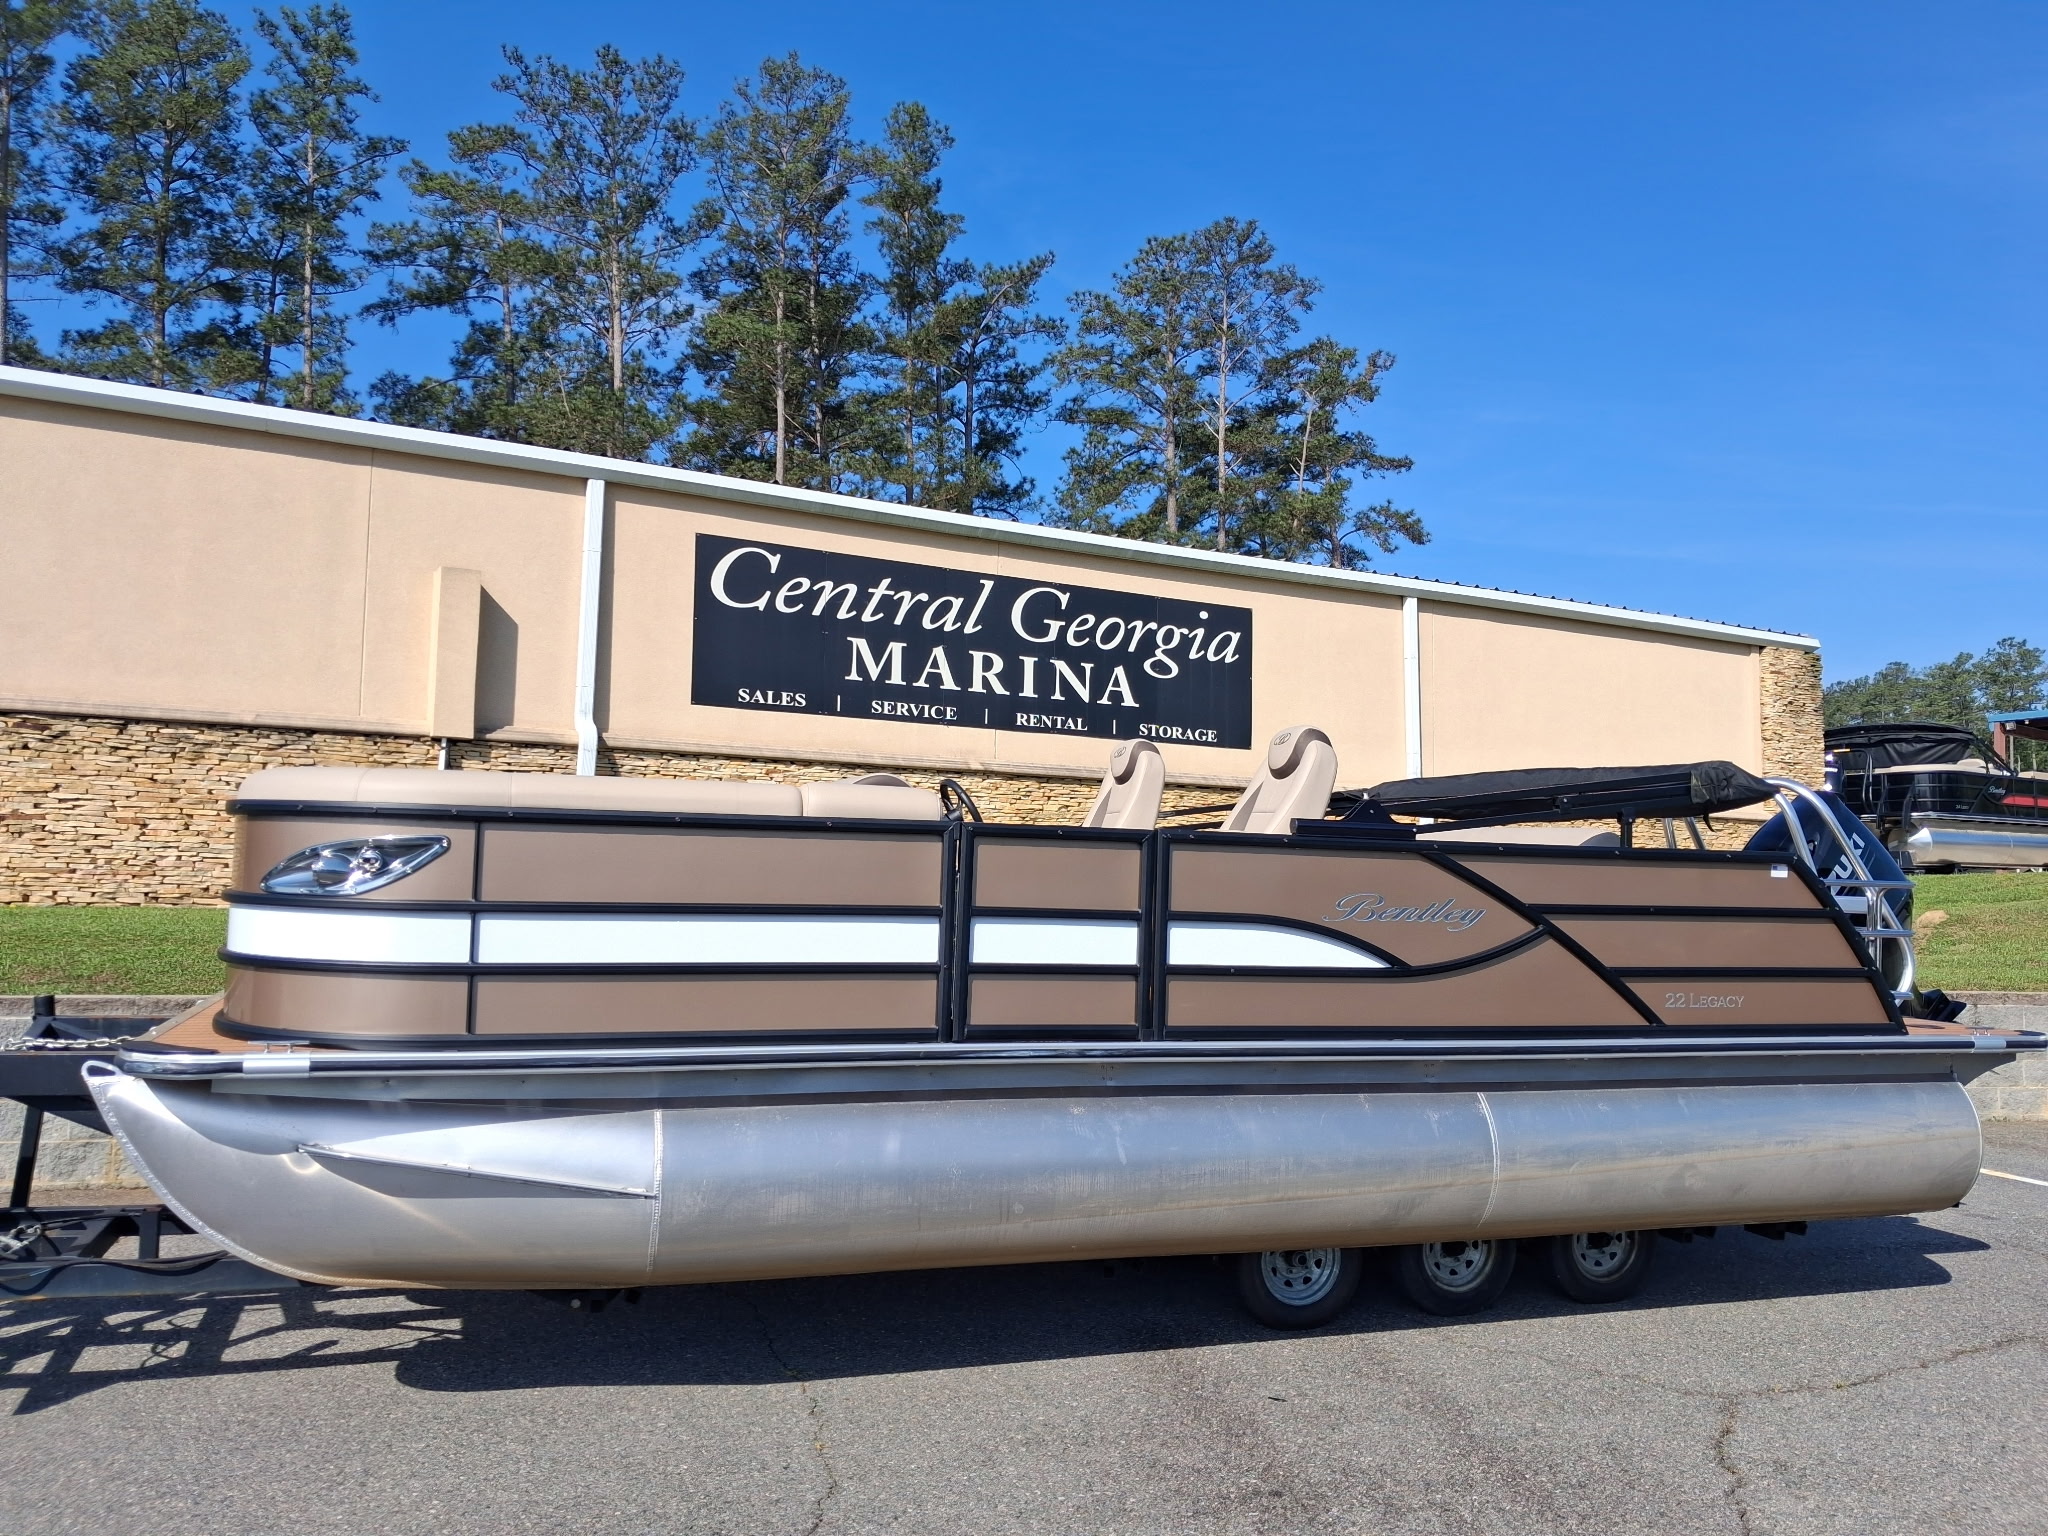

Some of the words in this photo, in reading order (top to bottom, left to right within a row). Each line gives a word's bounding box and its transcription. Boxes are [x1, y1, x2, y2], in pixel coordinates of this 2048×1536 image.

[710, 546, 995, 635] Central
[1010, 587, 1242, 679] Georgia
[844, 636, 1140, 708] MARINA
[737, 688, 807, 707] SALES
[871, 699, 958, 721] SERVICE
[1015, 712, 1088, 731] RENTAL
[1138, 723, 1218, 743] STORAGE
[1321, 892, 1487, 932] Bentley
[1665, 992, 1686, 1008] 22
[1689, 992, 1745, 1008] LEGACY
